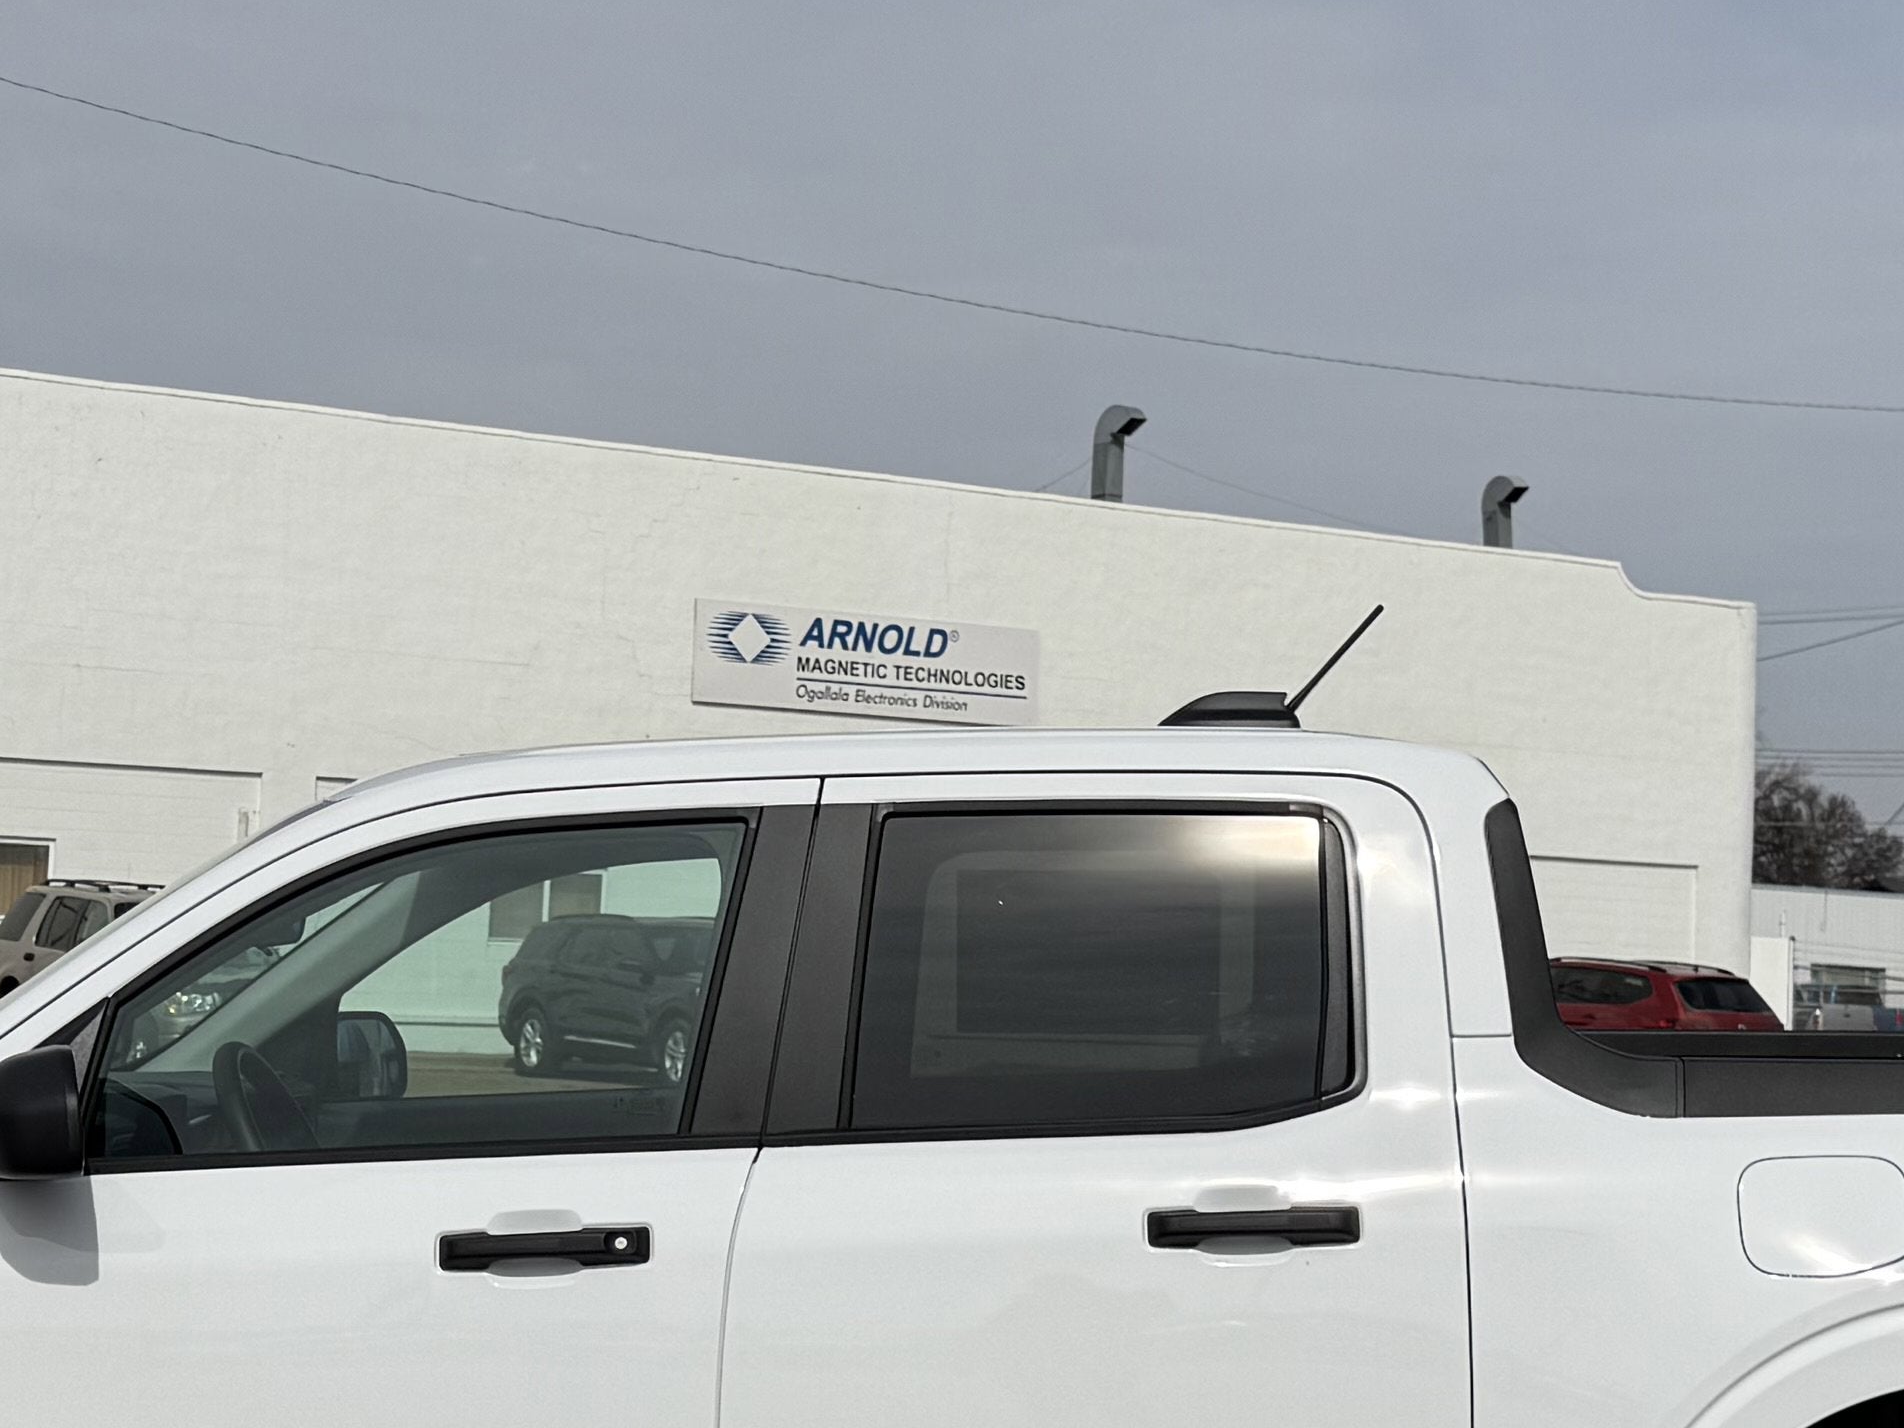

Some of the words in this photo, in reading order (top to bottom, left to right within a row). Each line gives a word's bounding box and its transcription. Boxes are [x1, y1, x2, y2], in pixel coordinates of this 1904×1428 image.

[796, 657, 888, 680] MAGNETIC
[895, 664, 1027, 691] TECHNOLOGIES
[796, 683, 850, 704] Ogallala
[854, 688, 918, 709] Electronics
[922, 694, 968, 712] Division
